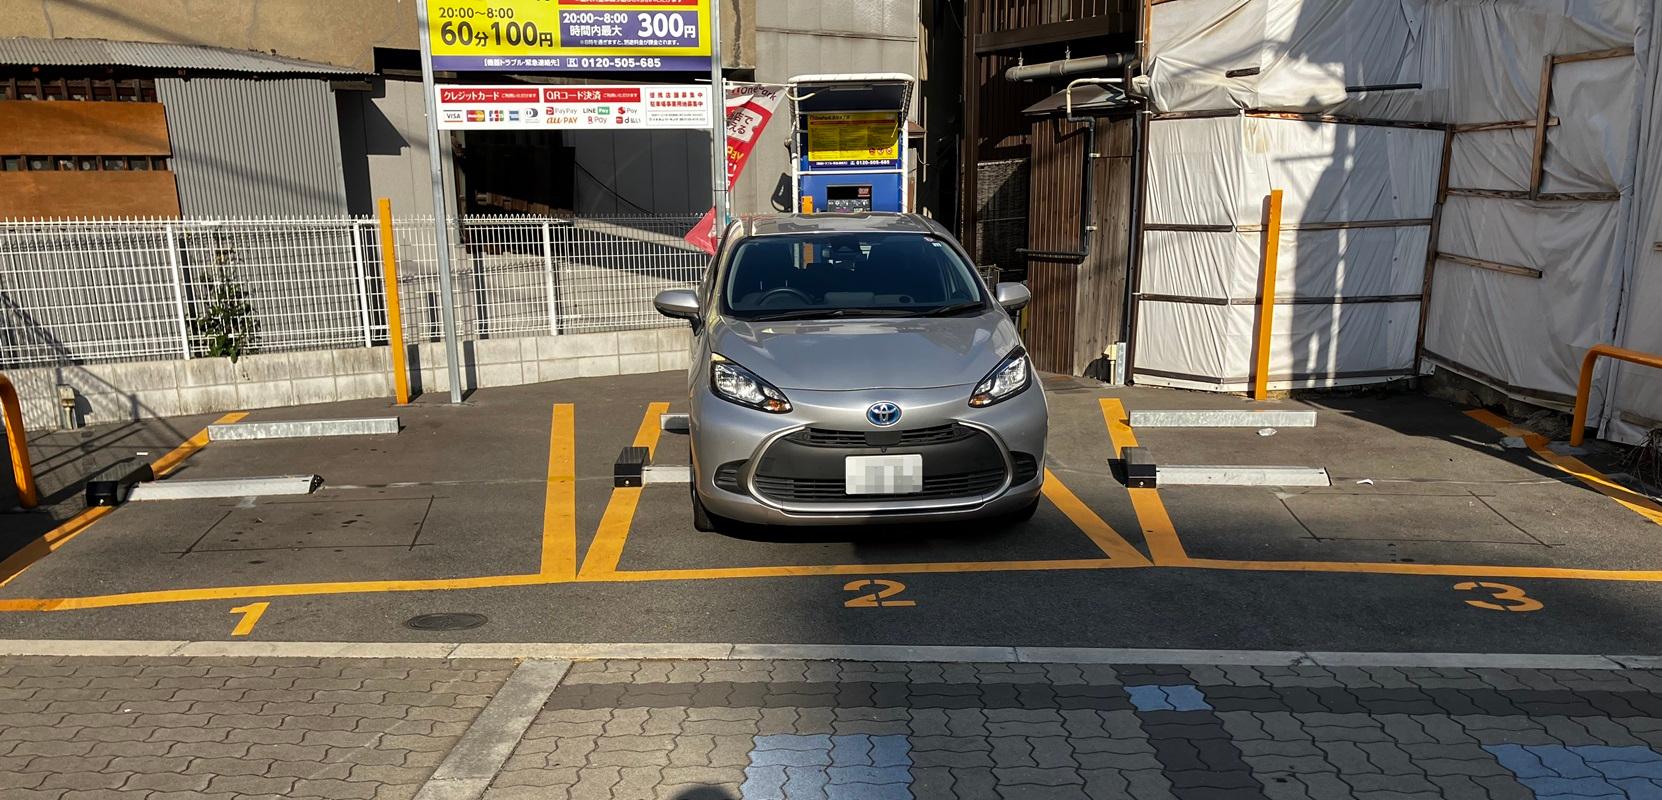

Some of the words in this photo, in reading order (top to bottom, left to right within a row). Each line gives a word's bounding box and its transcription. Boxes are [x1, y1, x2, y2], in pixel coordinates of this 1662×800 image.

[569, 25, 623, 37] 時間内最大
[637, 12, 696, 38] 300円
[440, 20, 554, 47] 60分100円
[581, 57, 661, 68] 0120-505-685
[443, 90, 500, 101] クレジットカード
[546, 90, 601, 101] QRコード決済
[555, 107, 577, 115] PayPay
[594, 116, 607, 124] Pay
[843, 579, 916, 608] 2
[1453, 581, 1545, 612] 3
[229, 602, 270, 636] 1
